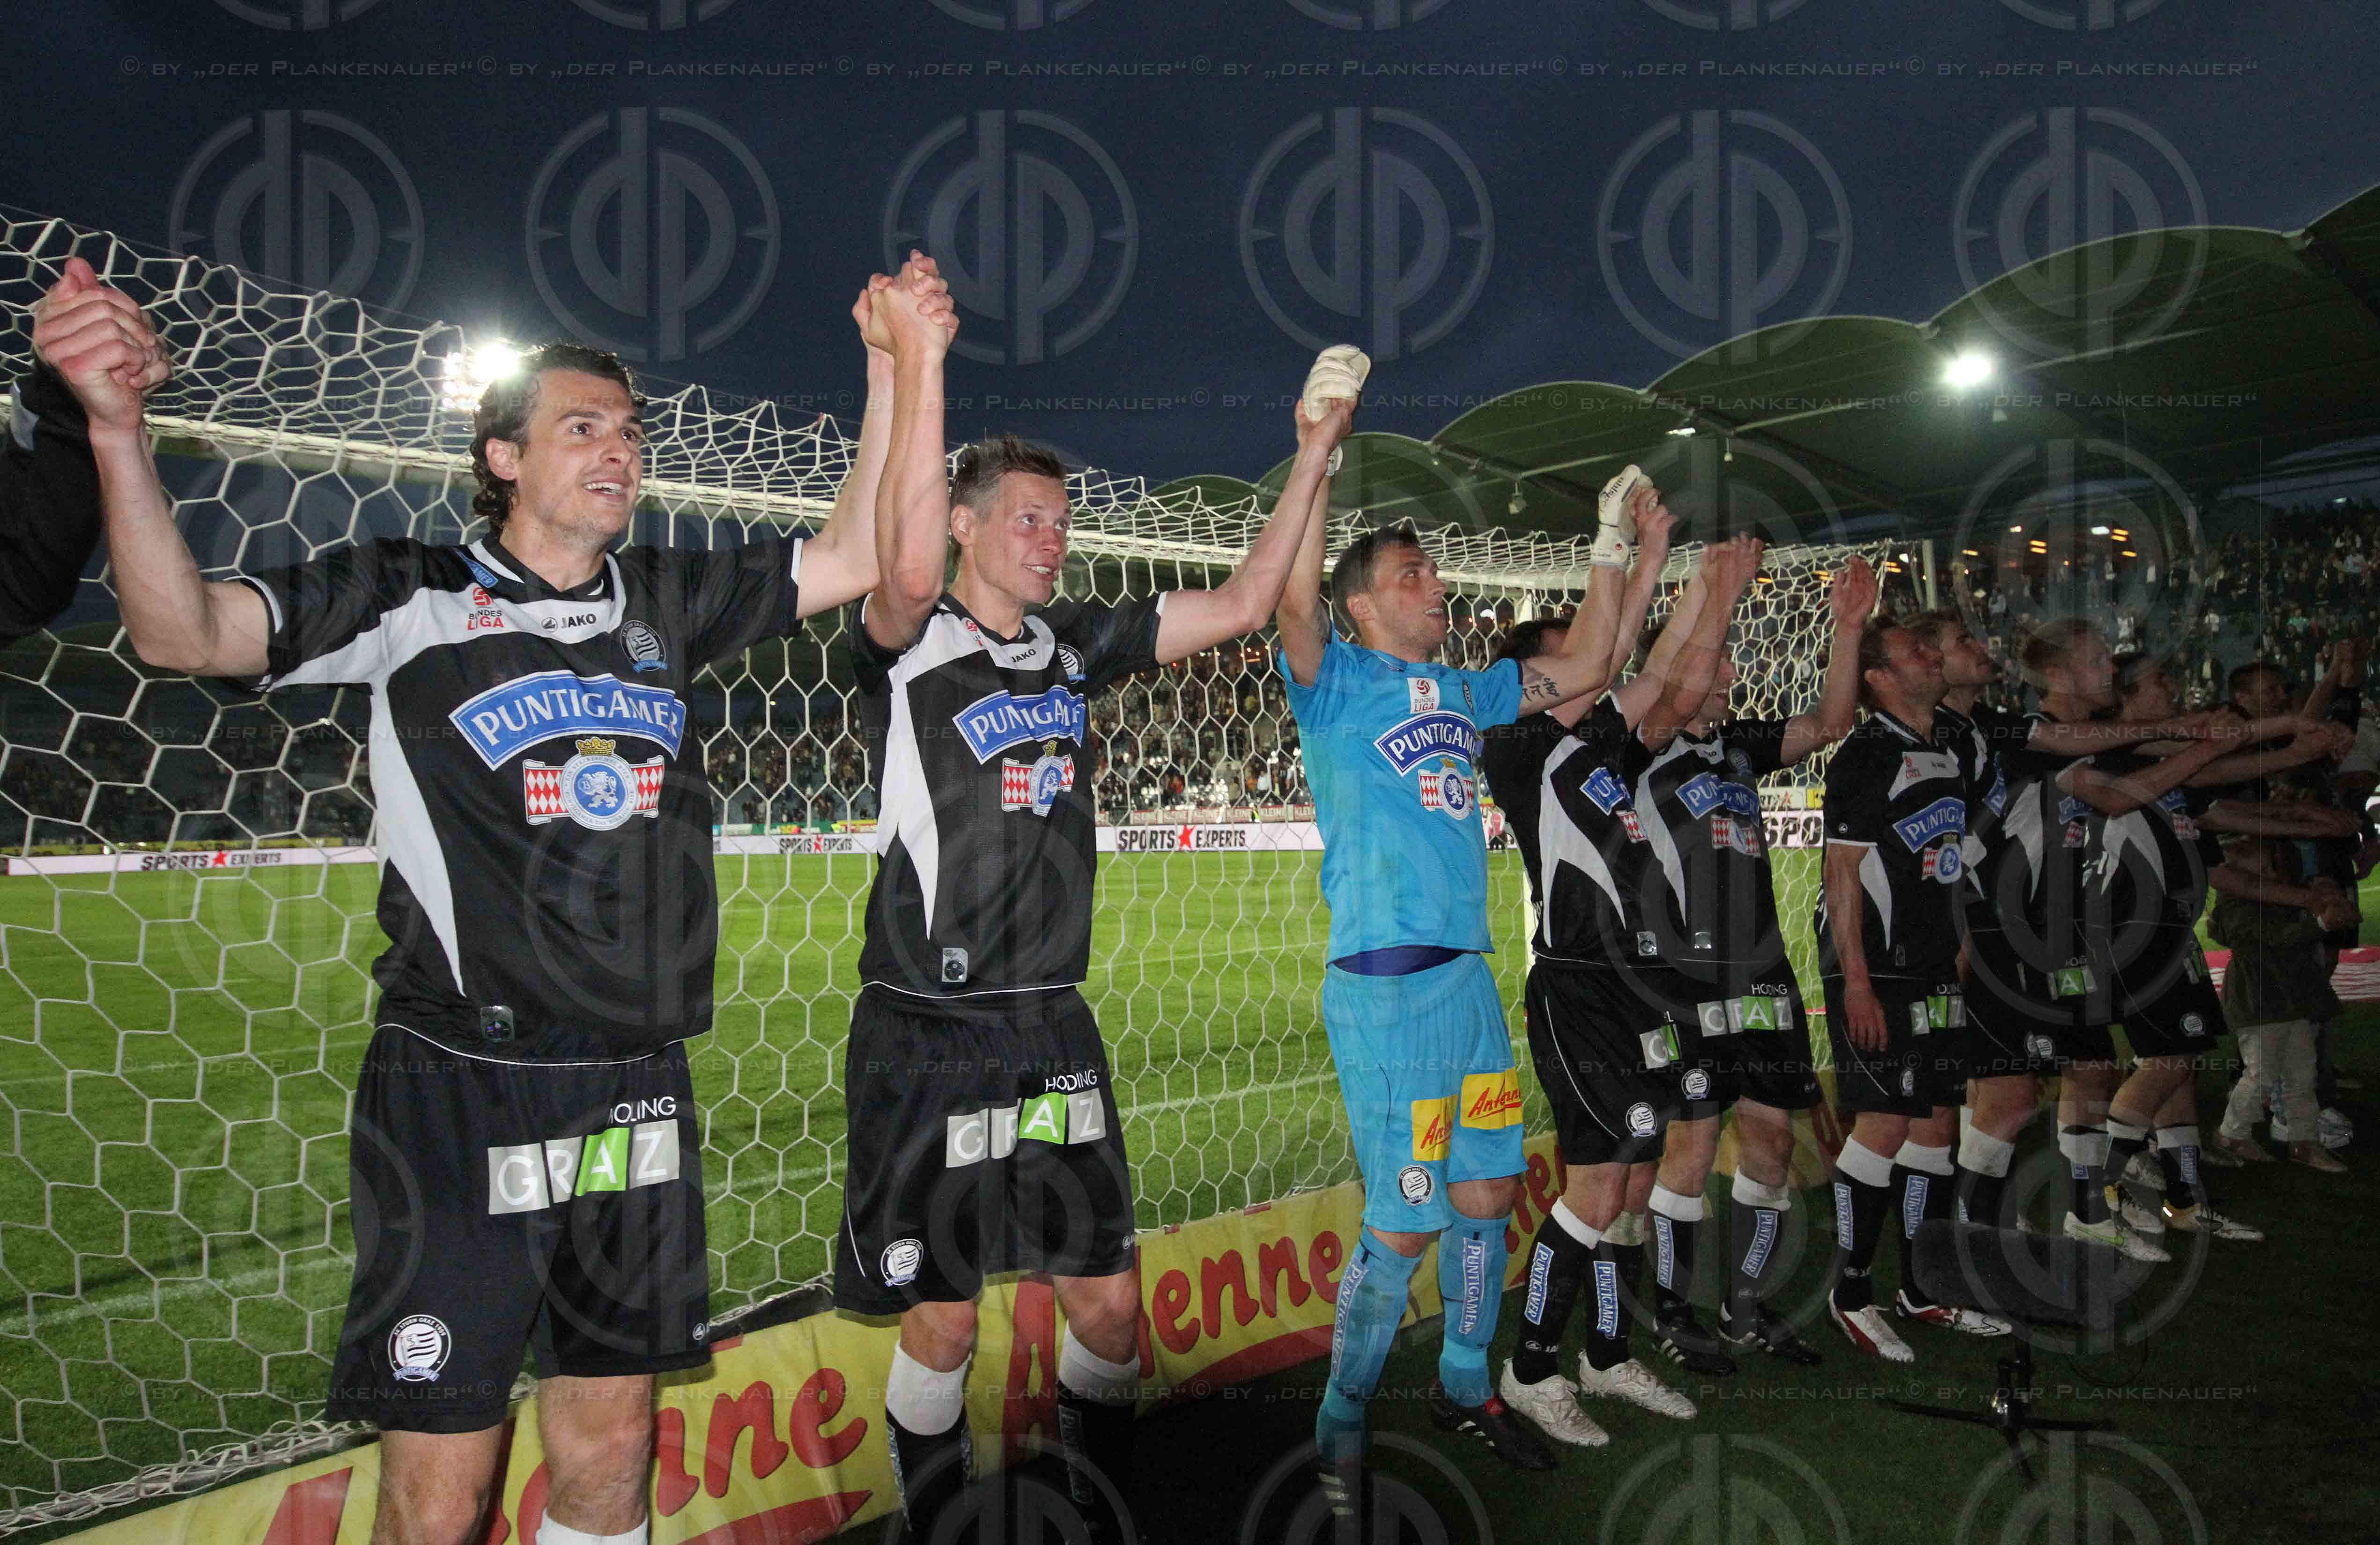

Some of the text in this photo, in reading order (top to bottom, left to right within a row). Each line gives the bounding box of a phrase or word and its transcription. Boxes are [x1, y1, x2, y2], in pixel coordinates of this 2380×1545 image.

[561, 612, 597, 629] JAKO
[1011, 648, 1036, 663] JAKO
[1414, 703, 1435, 712] LIGA
[779, 838, 812, 854] SPORTS
[1118, 830, 1246, 851] SPORTS EXPERTS
[141, 853, 209, 871] SPORTS
[497, 1130, 668, 1207] GRAZ
[1745, 1214, 1774, 1273] PUNTIGAMER
[1463, 1245, 1482, 1330] PUNTIGAMER
[1598, 1266, 1613, 1333] PUNTIGAMER
